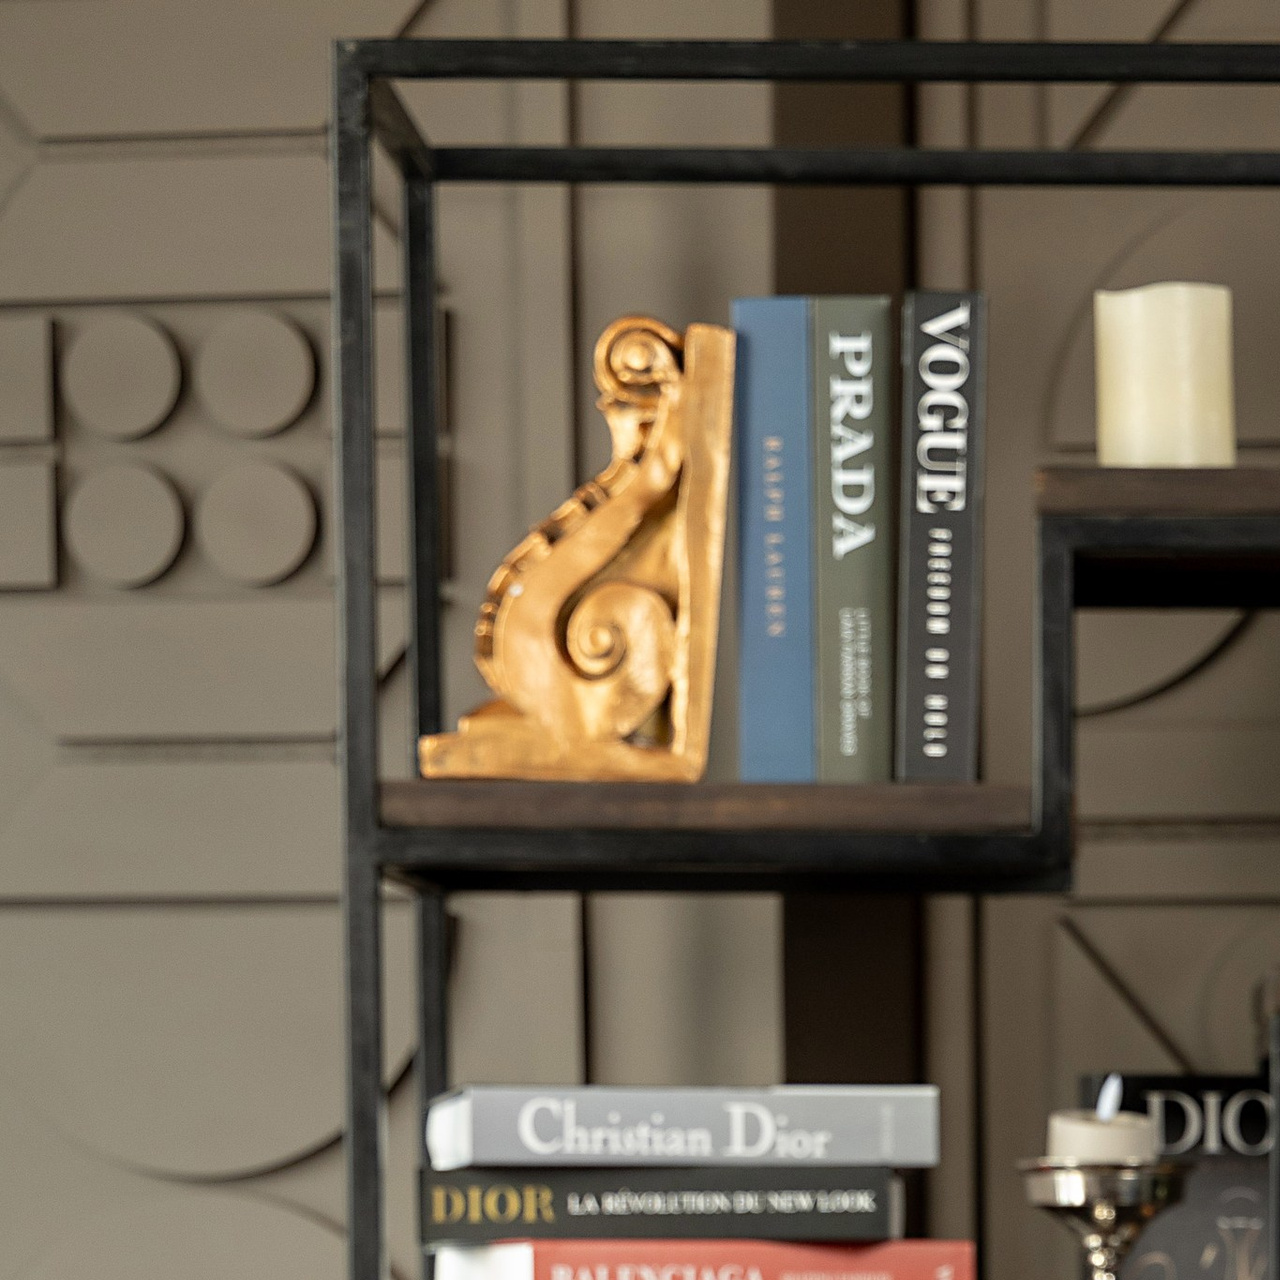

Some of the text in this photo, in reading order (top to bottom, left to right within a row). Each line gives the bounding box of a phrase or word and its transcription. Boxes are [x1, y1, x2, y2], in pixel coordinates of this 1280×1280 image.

[829, 331, 876, 560] PRADA
[916, 301, 971, 514] VOGUE
[518, 1097, 712, 1157] Christian
[723, 1102, 830, 1159] Dior
[430, 1186, 555, 1224] DIOR
[567, 1193, 600, 1216] LA
[731, 1191, 763, 1215] DU
[764, 1191, 812, 1214] NEW
[813, 1190, 876, 1213] LOOK
